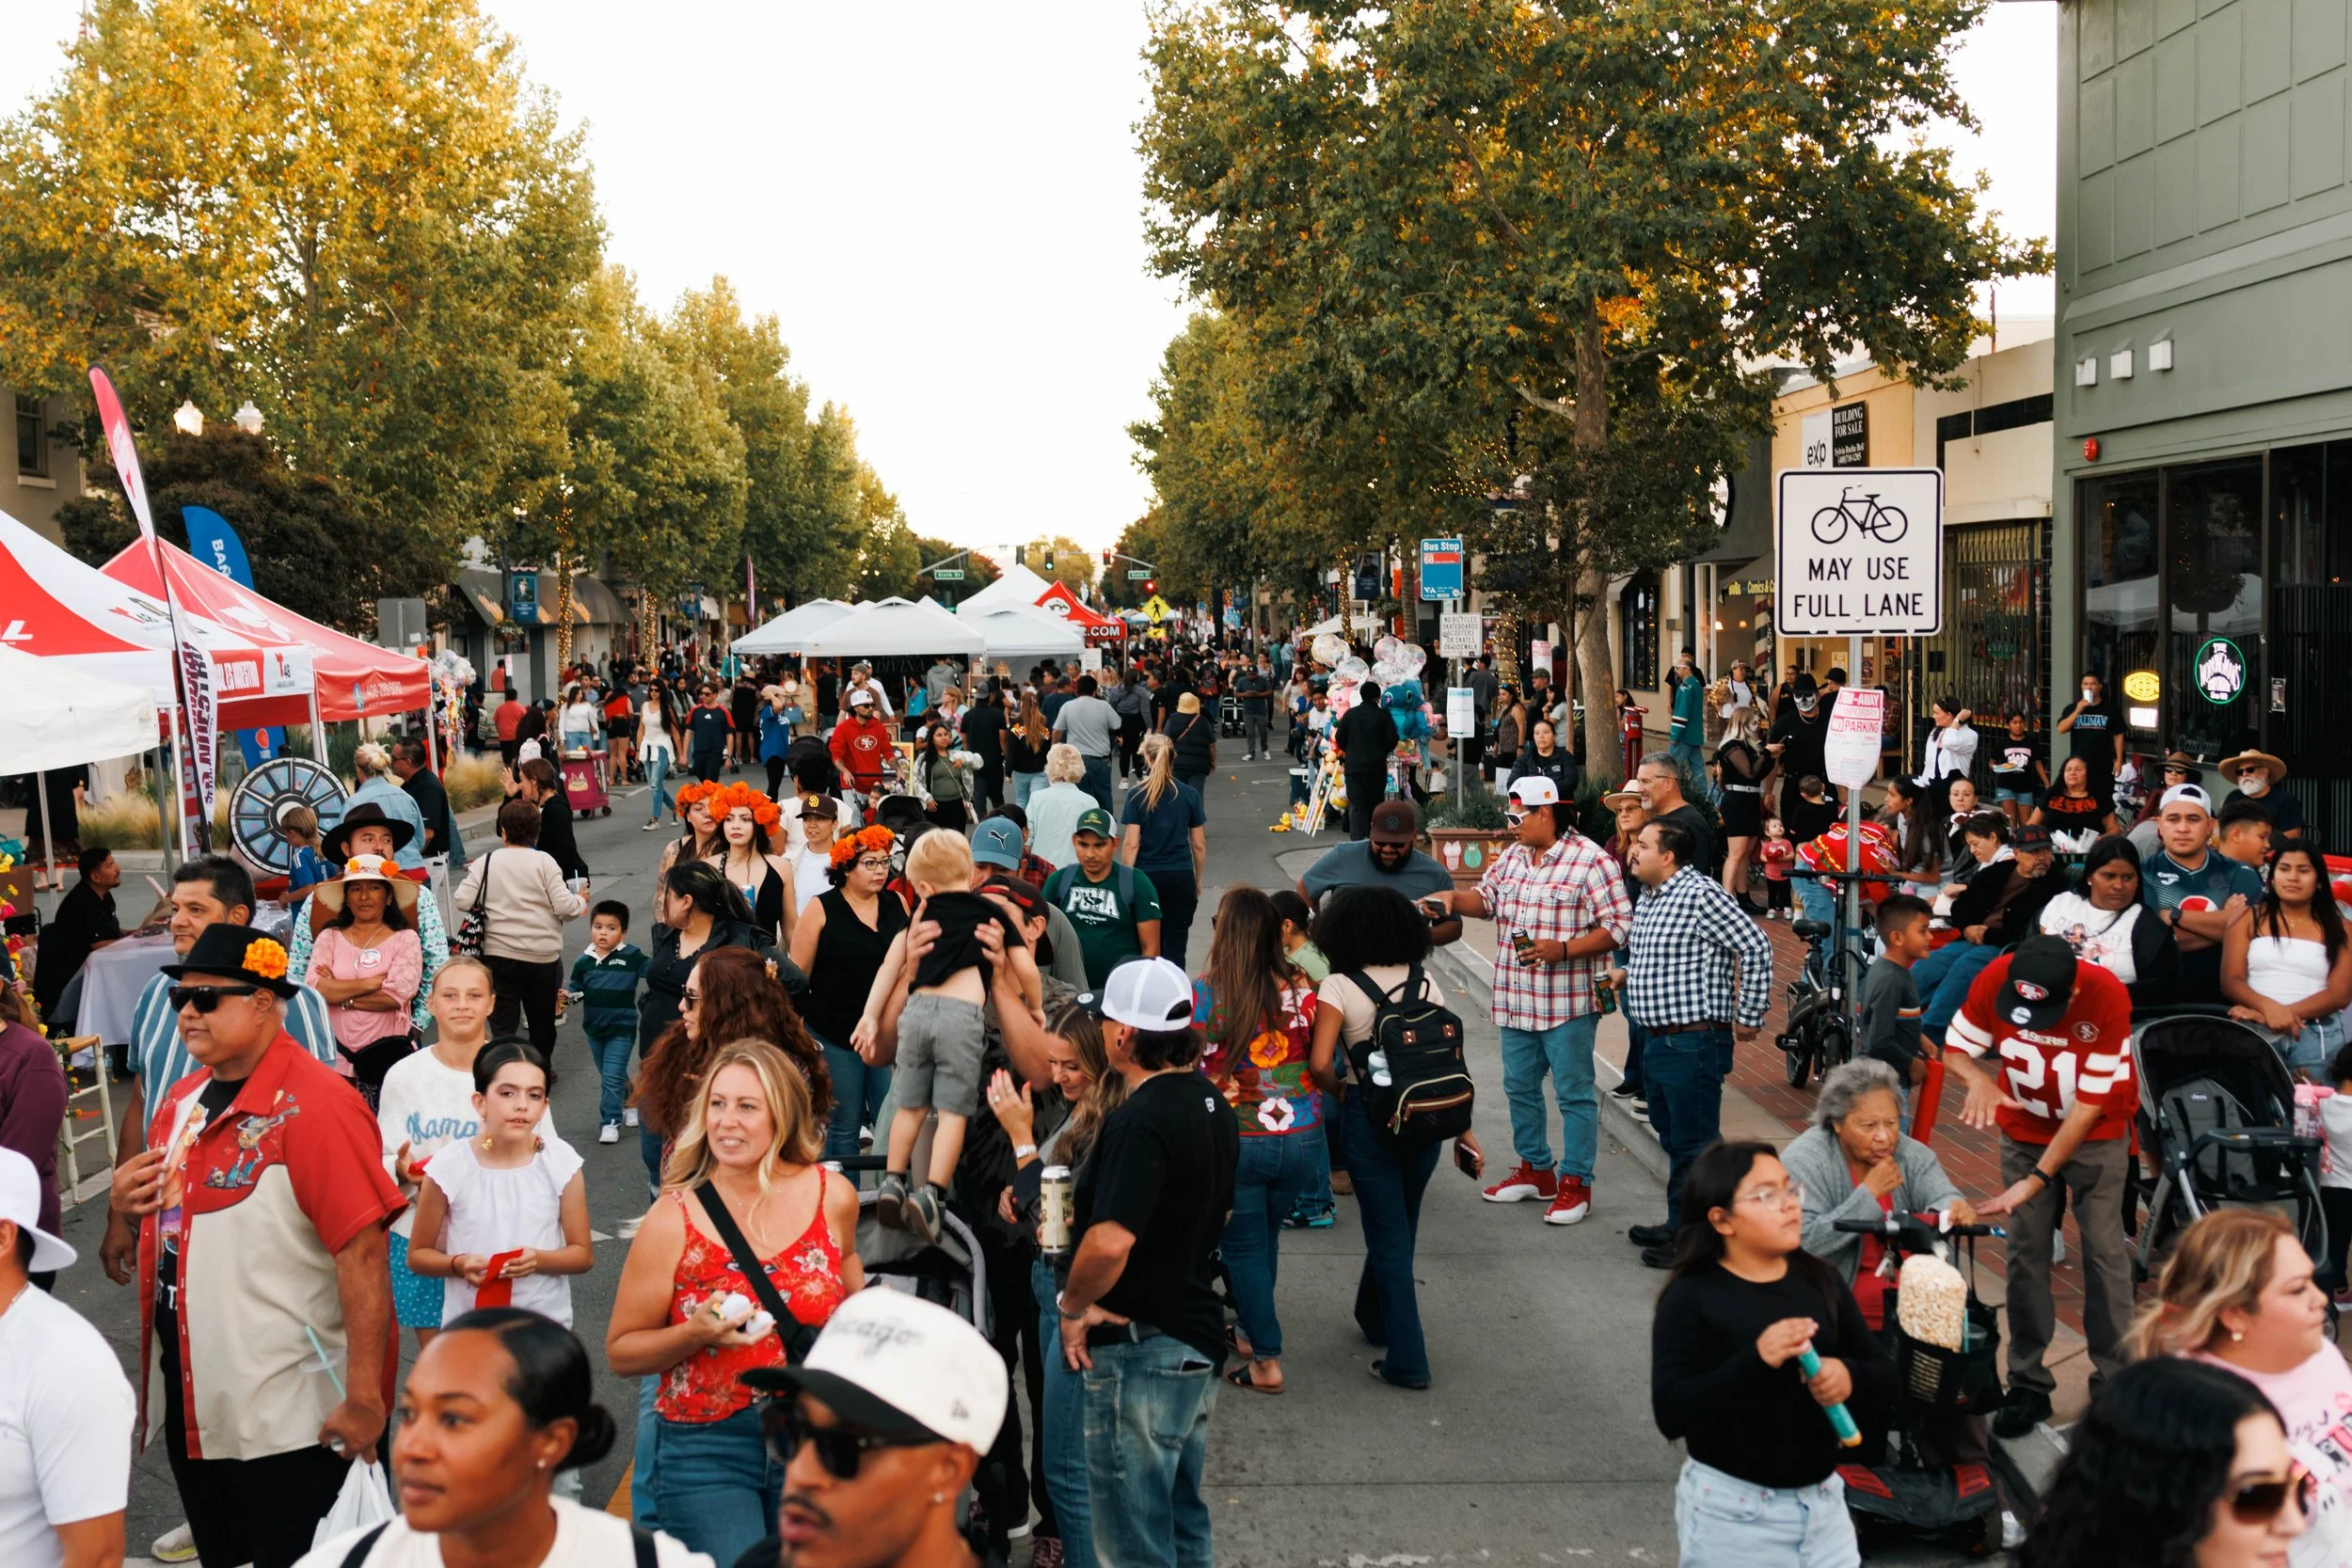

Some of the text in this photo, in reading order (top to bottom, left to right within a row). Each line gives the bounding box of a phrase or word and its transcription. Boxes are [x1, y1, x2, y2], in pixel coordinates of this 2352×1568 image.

[1834, 406, 1863, 425] BUILDING
[1835, 420, 1863, 438] FOR SALE
[1422, 542, 1460, 552] Bus Stop
[1809, 557, 1909, 580] MAY USE
[1794, 594, 1923, 617] FULL LANE
[1844, 720, 1879, 734] PARKING
[1066, 887, 1120, 919] PUMA
[2016, 1029, 2069, 1048] 49ERS
[1999, 1037, 2077, 1119] 21
